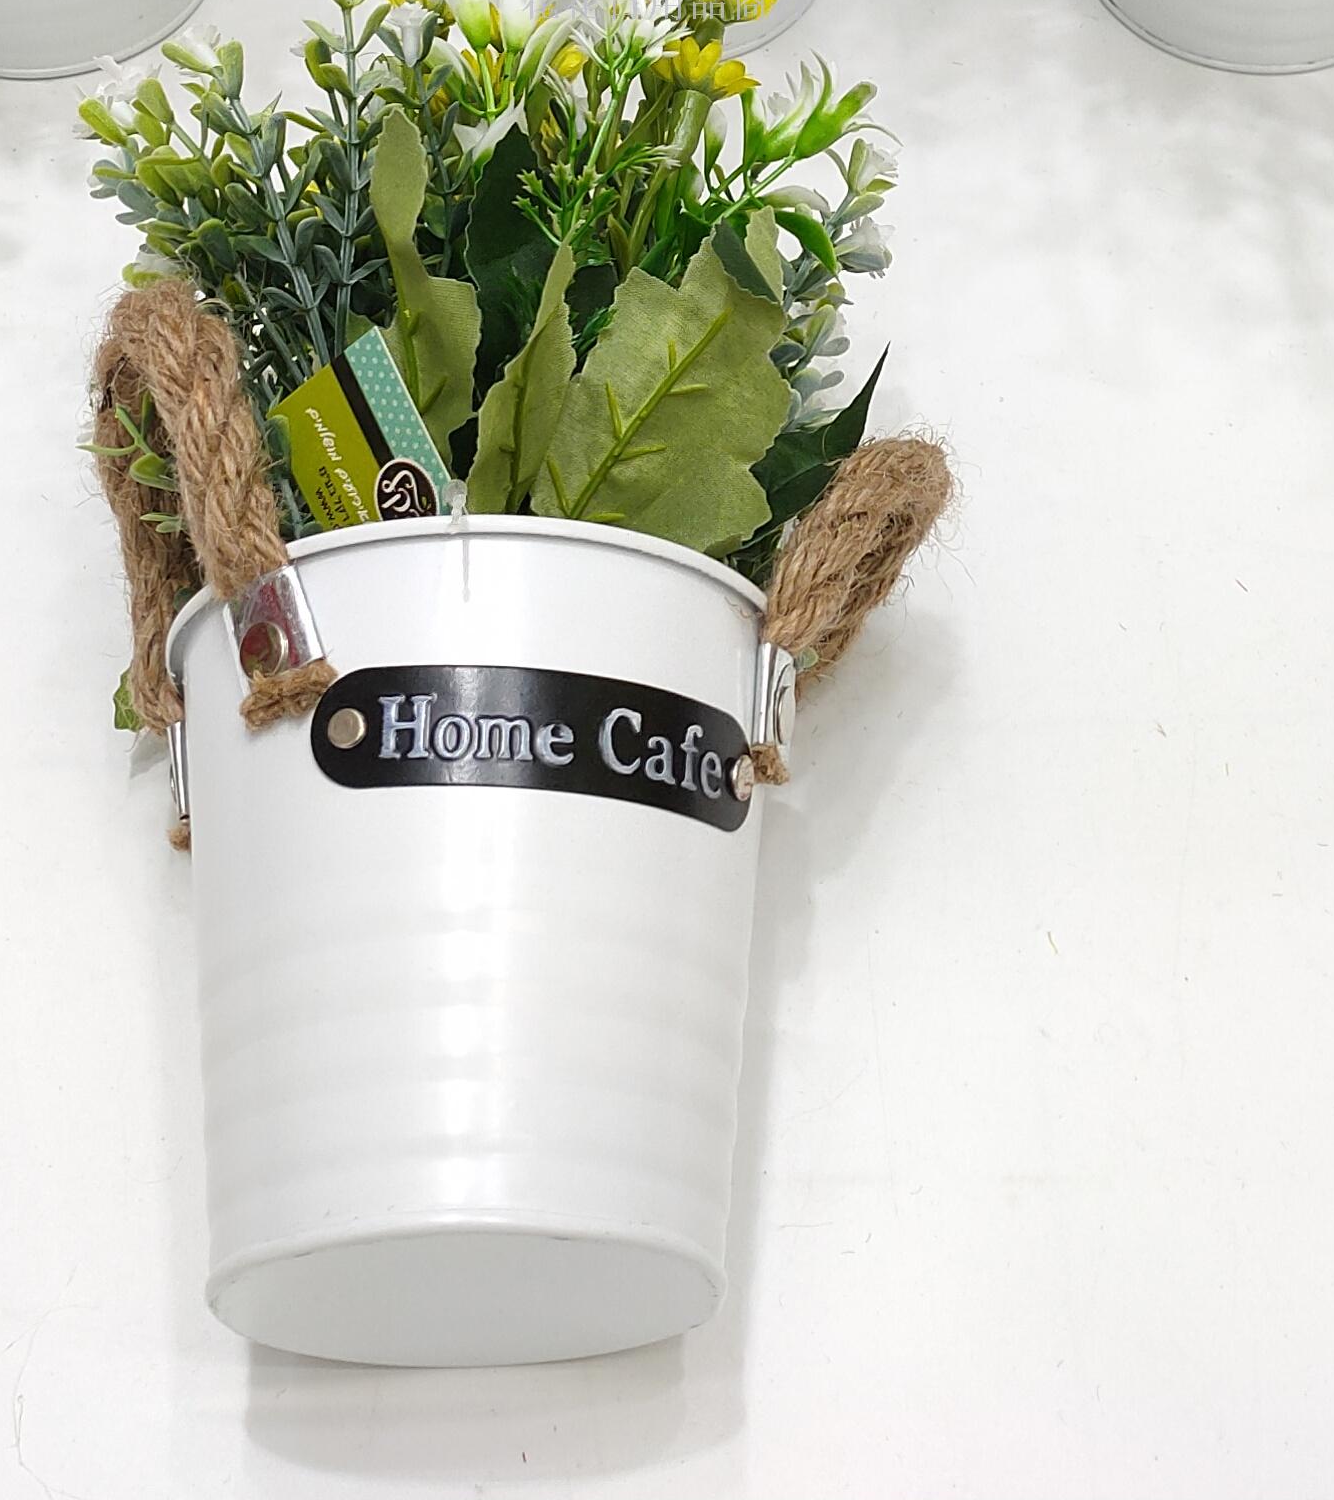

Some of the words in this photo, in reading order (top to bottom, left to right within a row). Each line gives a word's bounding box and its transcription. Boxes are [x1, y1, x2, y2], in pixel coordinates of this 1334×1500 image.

[304, 407, 343, 462] מושלמים
[378, 693, 576, 766] Home
[599, 707, 723, 800] Cafe
